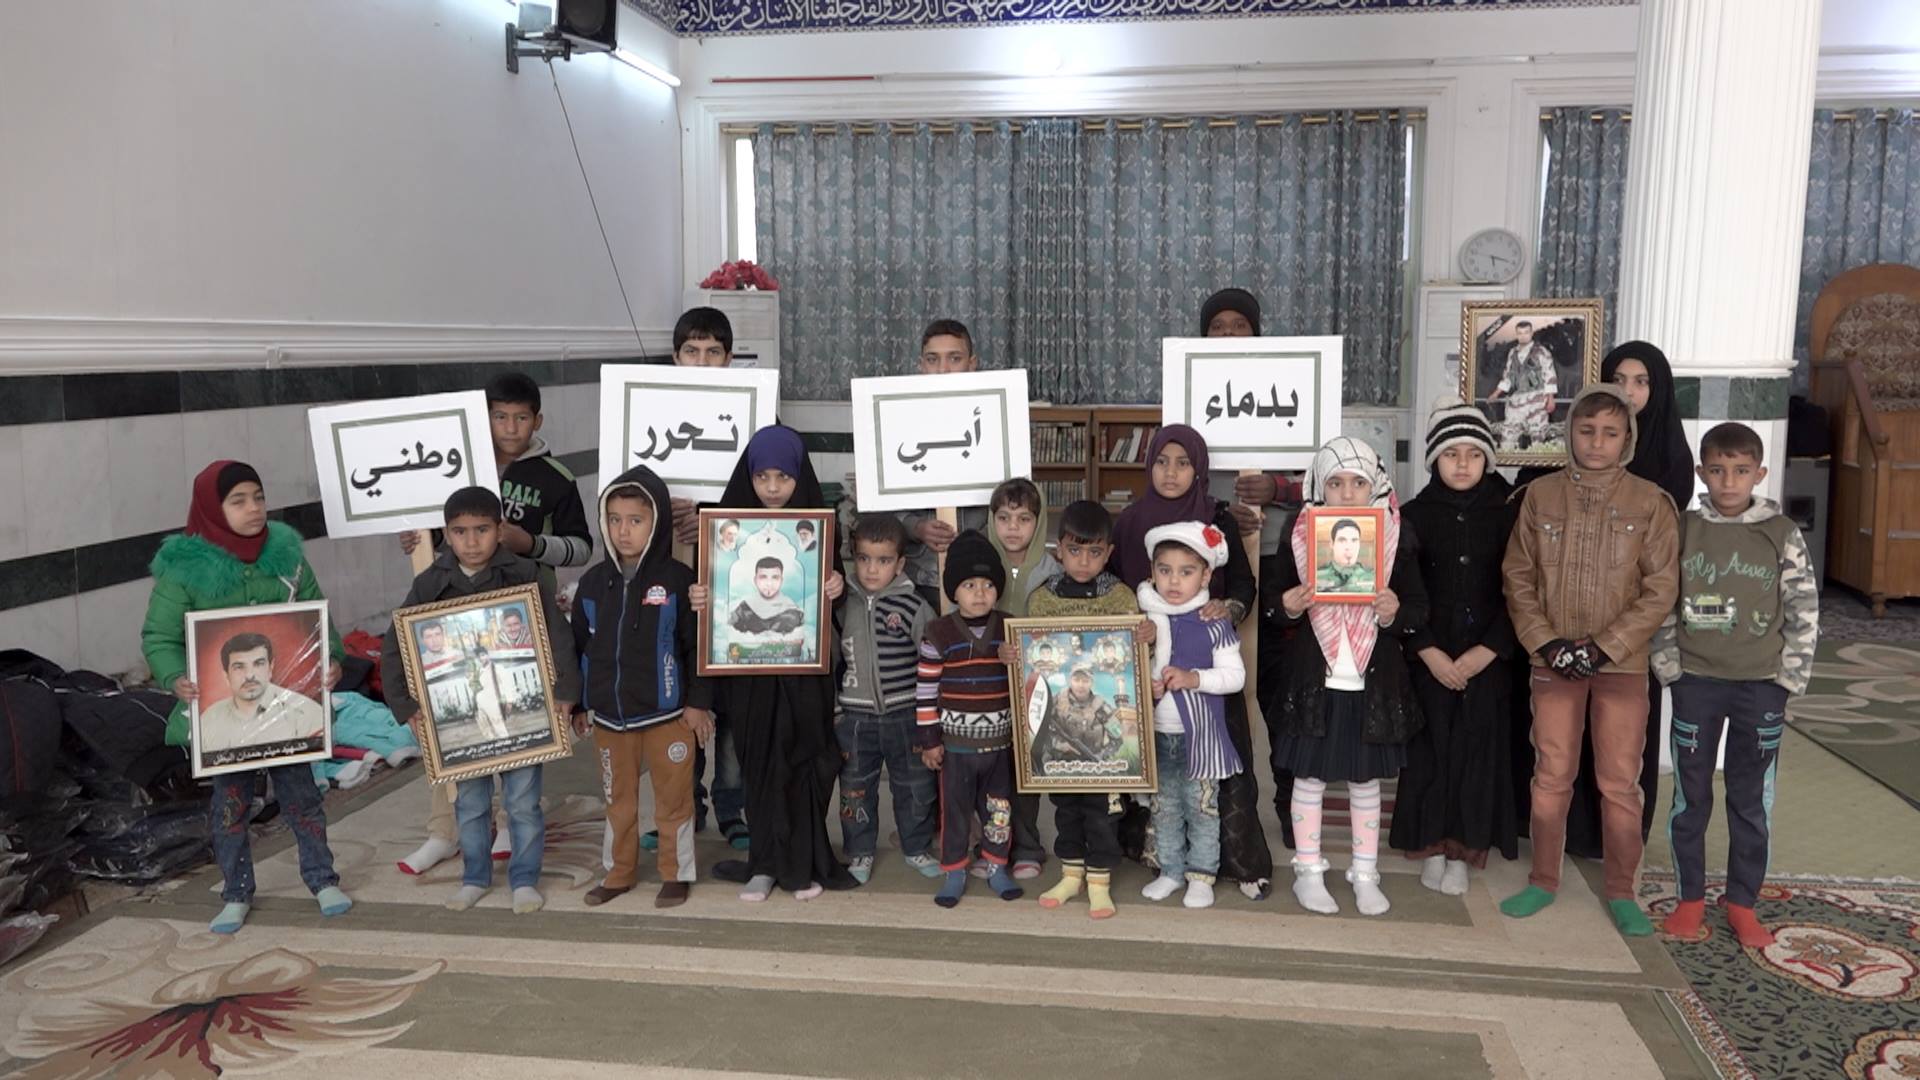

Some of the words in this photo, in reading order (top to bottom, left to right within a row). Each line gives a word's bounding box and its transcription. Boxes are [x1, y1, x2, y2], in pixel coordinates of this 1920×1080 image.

[1203, 381, 1299, 427] بدماء
[634, 413, 739, 462] تحرر
[897, 406, 982, 472] أبي
[350, 440, 463, 498] وطني
[1683, 551, 1717, 585] Fly
[1719, 551, 1776, 591] Away
